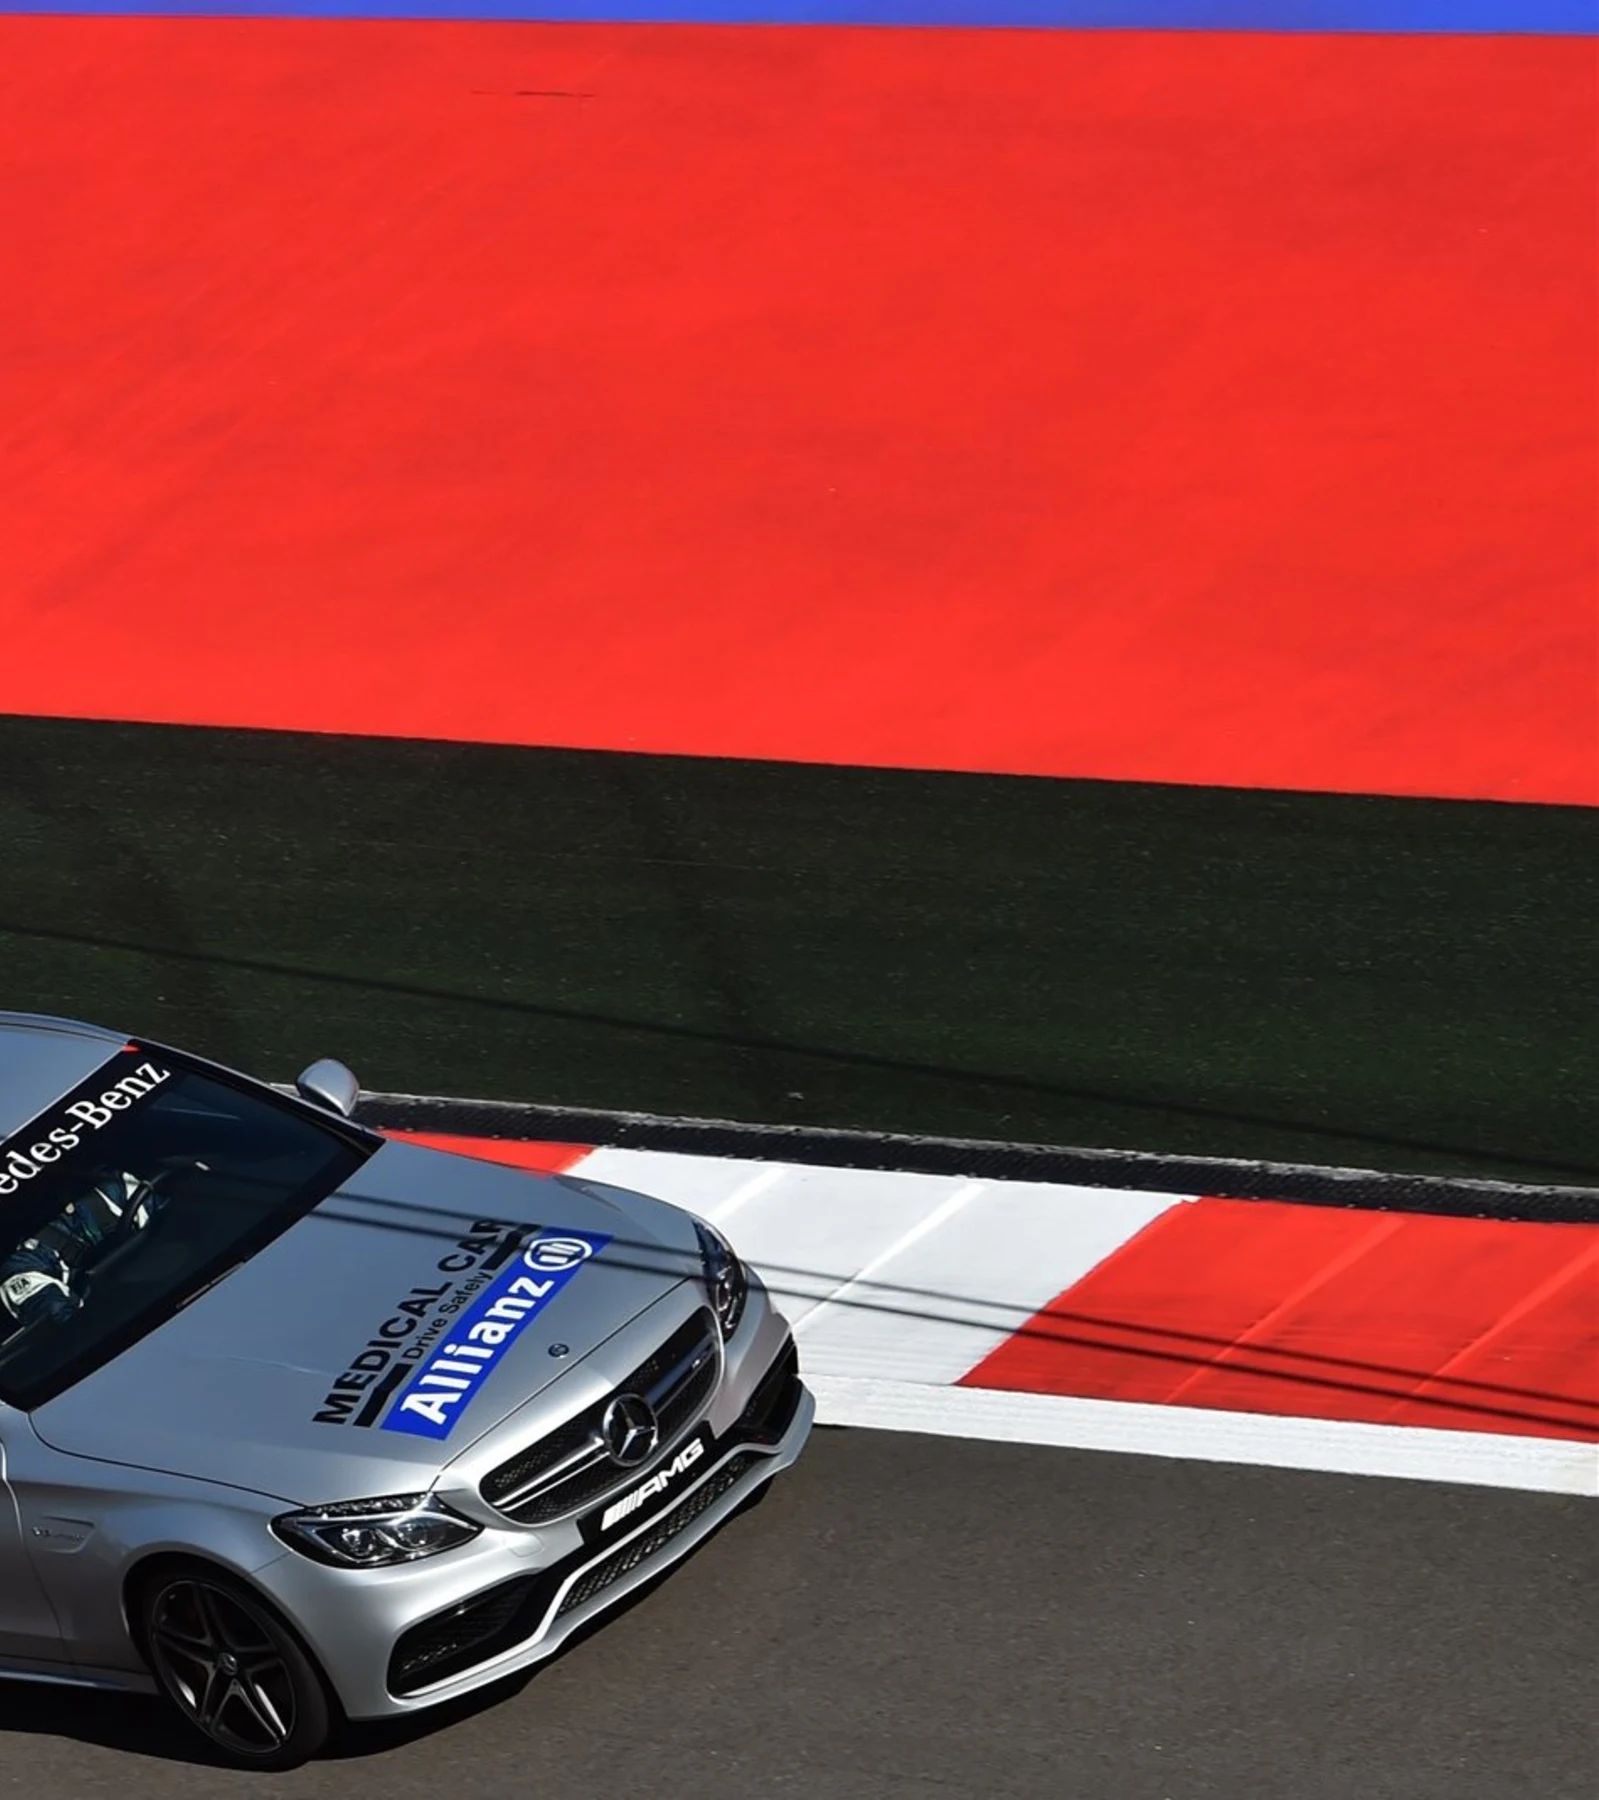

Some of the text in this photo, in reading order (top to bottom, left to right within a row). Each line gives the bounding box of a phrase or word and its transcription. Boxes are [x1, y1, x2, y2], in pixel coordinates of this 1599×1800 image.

[10, 1278, 30, 1295] FIA
[312, 1218, 512, 1425] MEDICAL CAR
[402, 1271, 493, 1360] Drive Safely
[400, 1277, 555, 1425] Allianz
[636, 1437, 705, 1511] AMG
